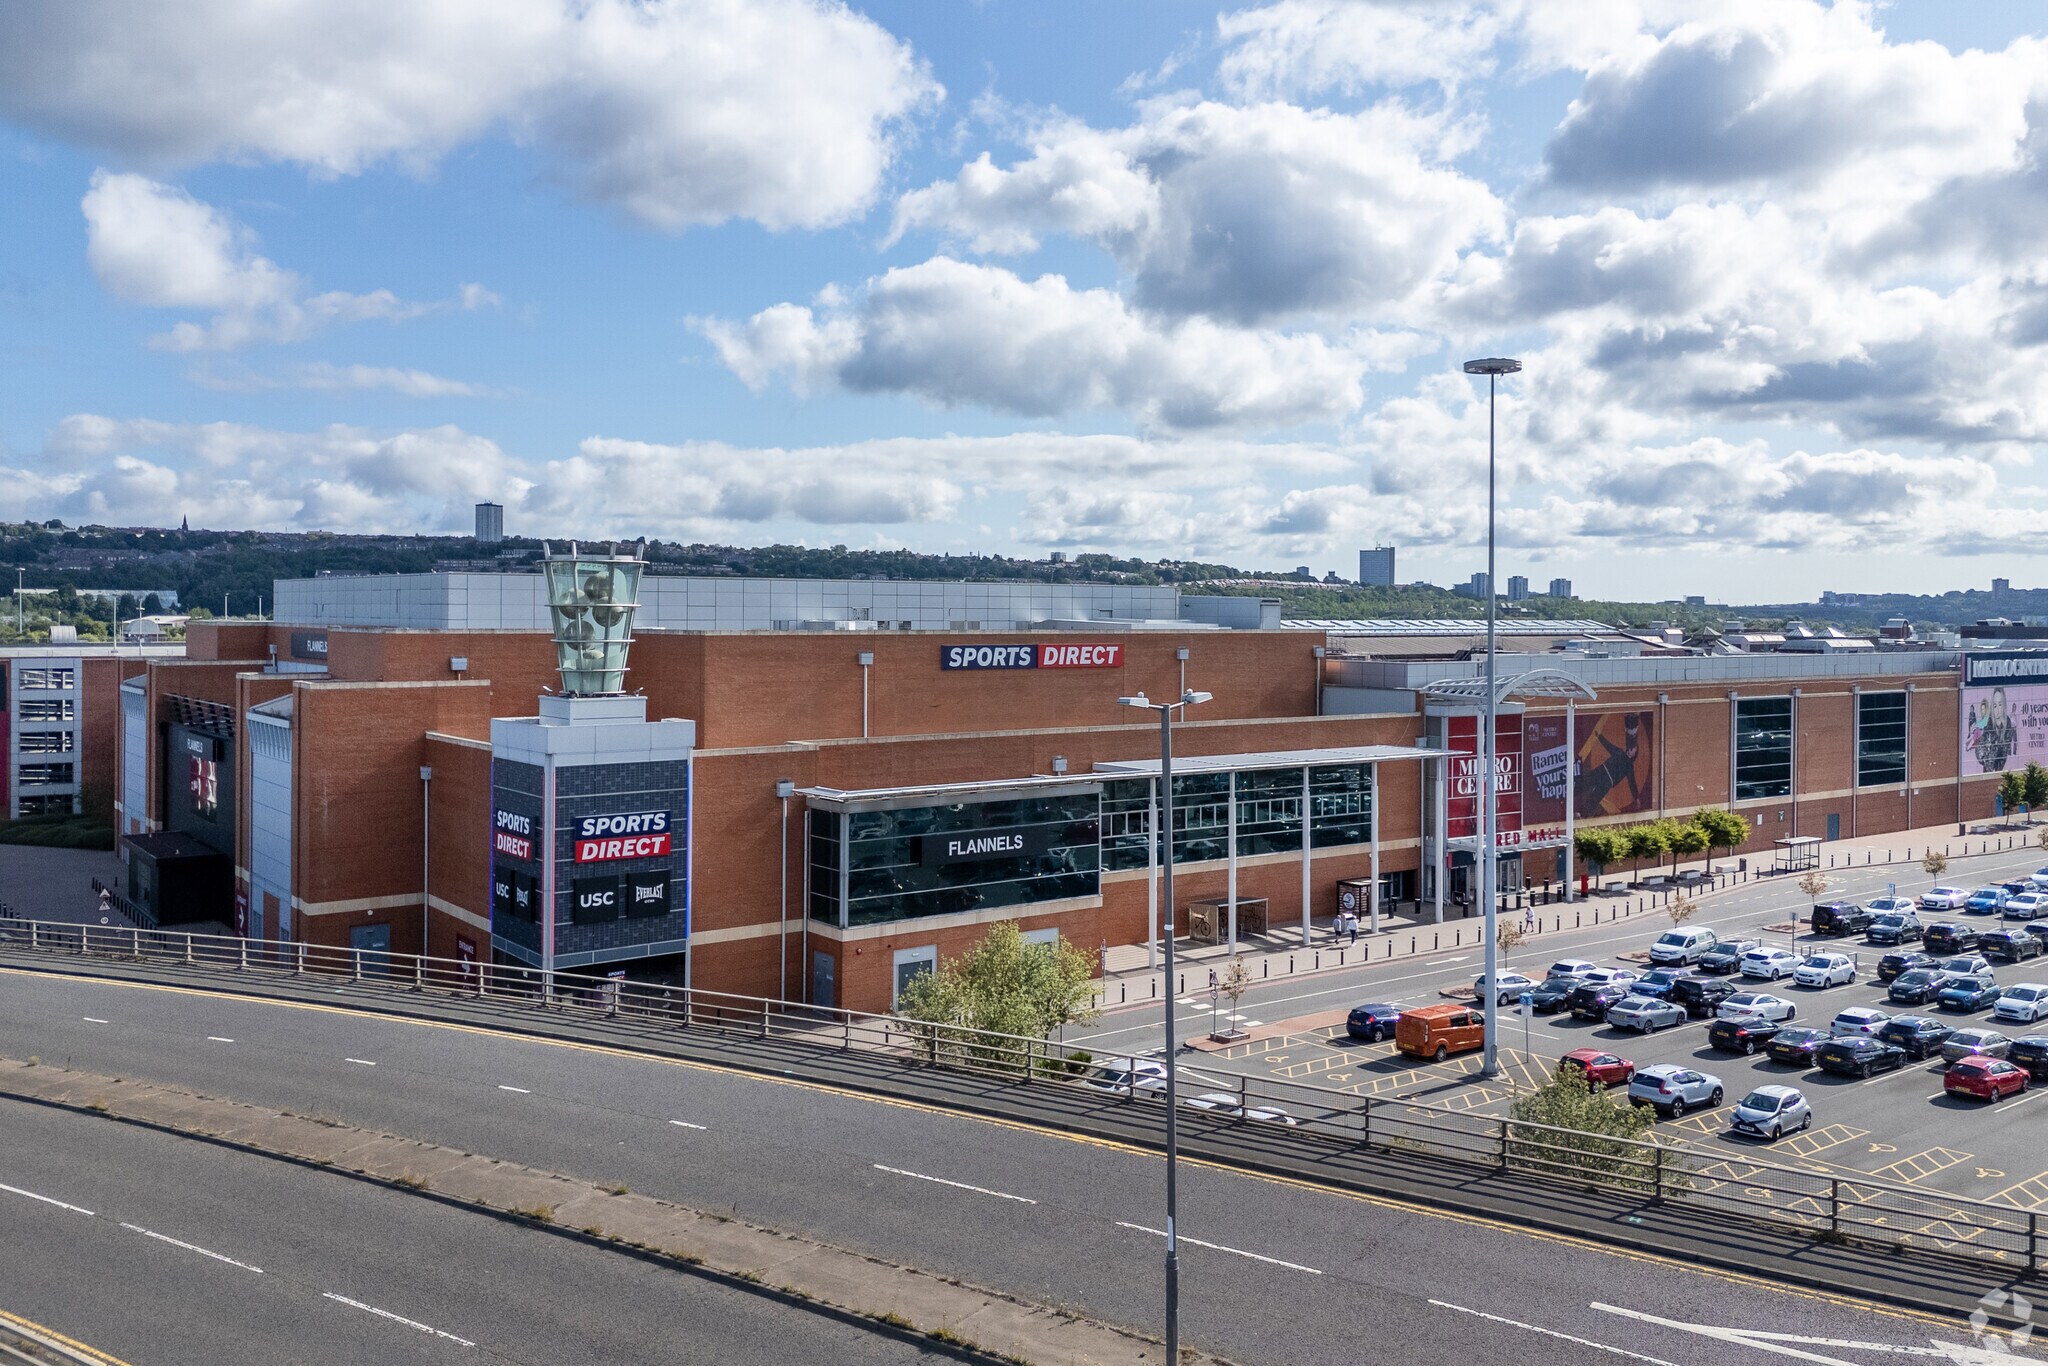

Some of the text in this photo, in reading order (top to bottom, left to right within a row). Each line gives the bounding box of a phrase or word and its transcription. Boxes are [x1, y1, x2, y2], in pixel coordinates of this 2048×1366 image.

[948, 645, 1119, 668] SPORTS DIRECT
[1533, 751, 1567, 770] Rame
[497, 810, 530, 835] SPORTS
[581, 813, 666, 836] SPORTS
[497, 833, 530, 858] DIRECT
[948, 834, 1024, 857] FLANNELS
[1496, 826, 1561, 846] RED MALL
[581, 836, 666, 861] DIRECT
[496, 882, 510, 899] USC
[580, 891, 614, 908] USC
[635, 883, 664, 902] EVERLAST
